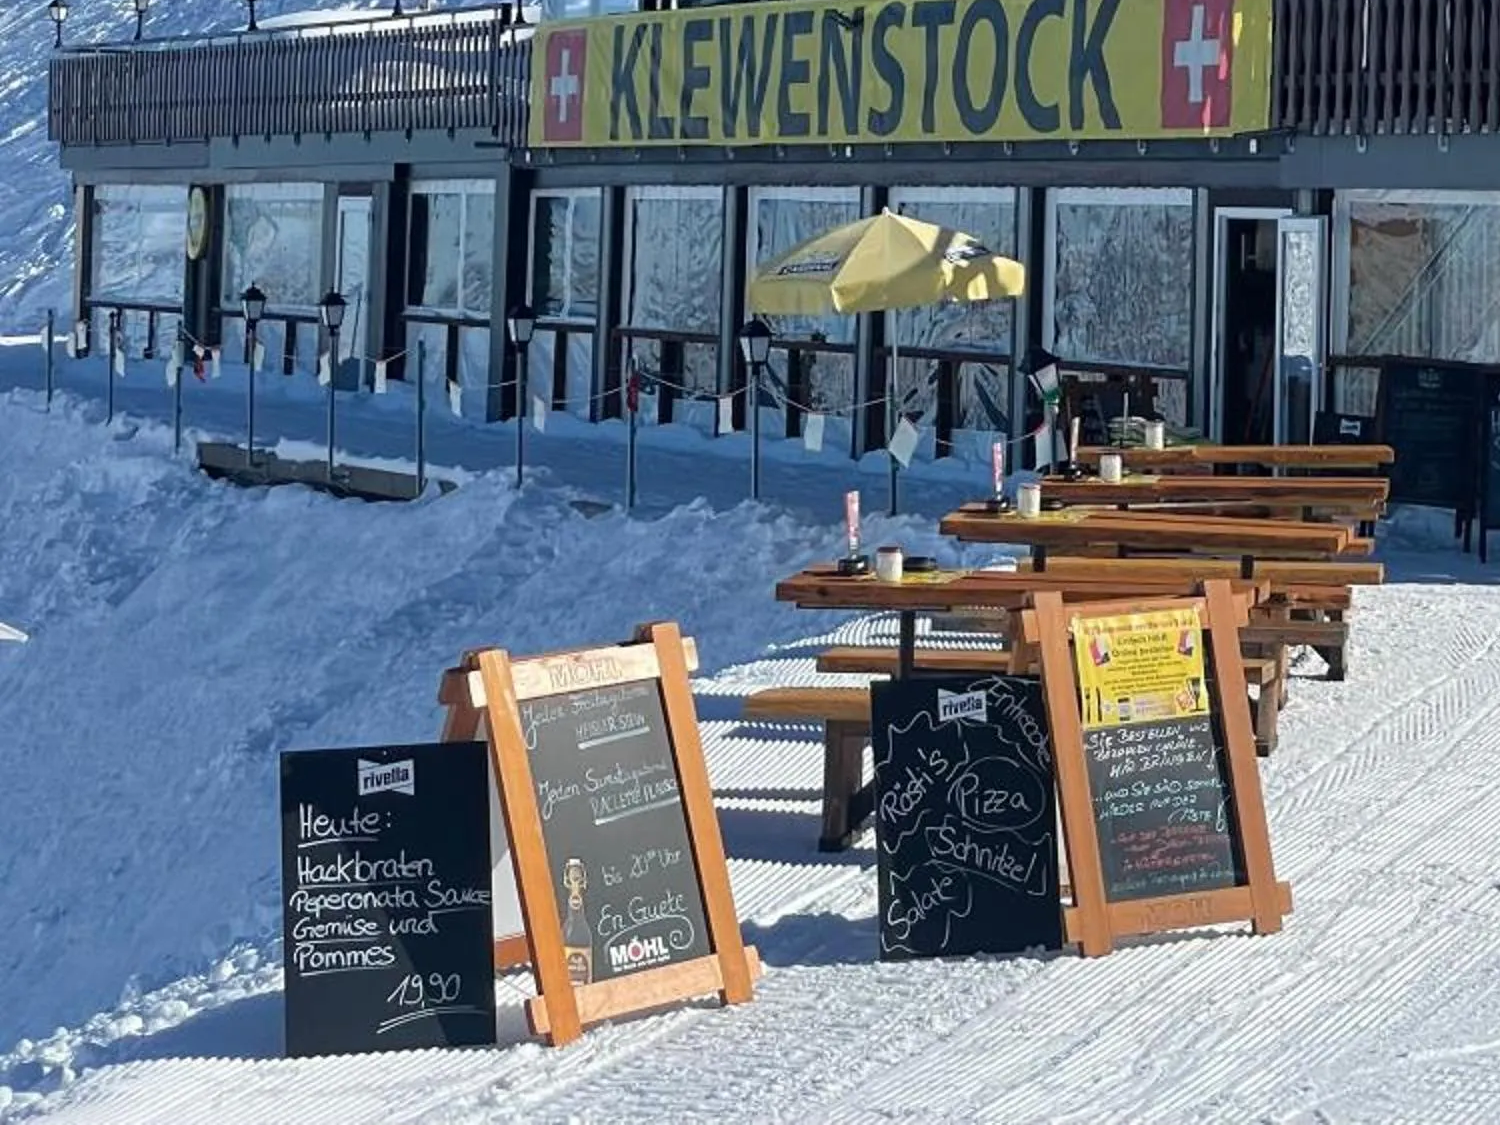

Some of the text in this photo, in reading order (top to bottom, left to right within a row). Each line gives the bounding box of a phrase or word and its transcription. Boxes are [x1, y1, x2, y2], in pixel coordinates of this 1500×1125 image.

[943, 695, 983, 717] rivella
[363, 766, 410, 790] rivella
[880, 747, 948, 823] Rösti's
[949, 772, 1032, 818] Pizza
[299, 803, 392, 838] Heute:
[297, 850, 433, 884] Hackbraten
[934, 827, 1037, 884] Schnitzel
[289, 891, 417, 918] Peperonata
[887, 875, 959, 940] Salate
[293, 915, 439, 941] Gemüse und
[293, 943, 396, 970] Pommes
[610, 935, 669, 966] MÖHL
[387, 972, 461, 1007] 19,90
